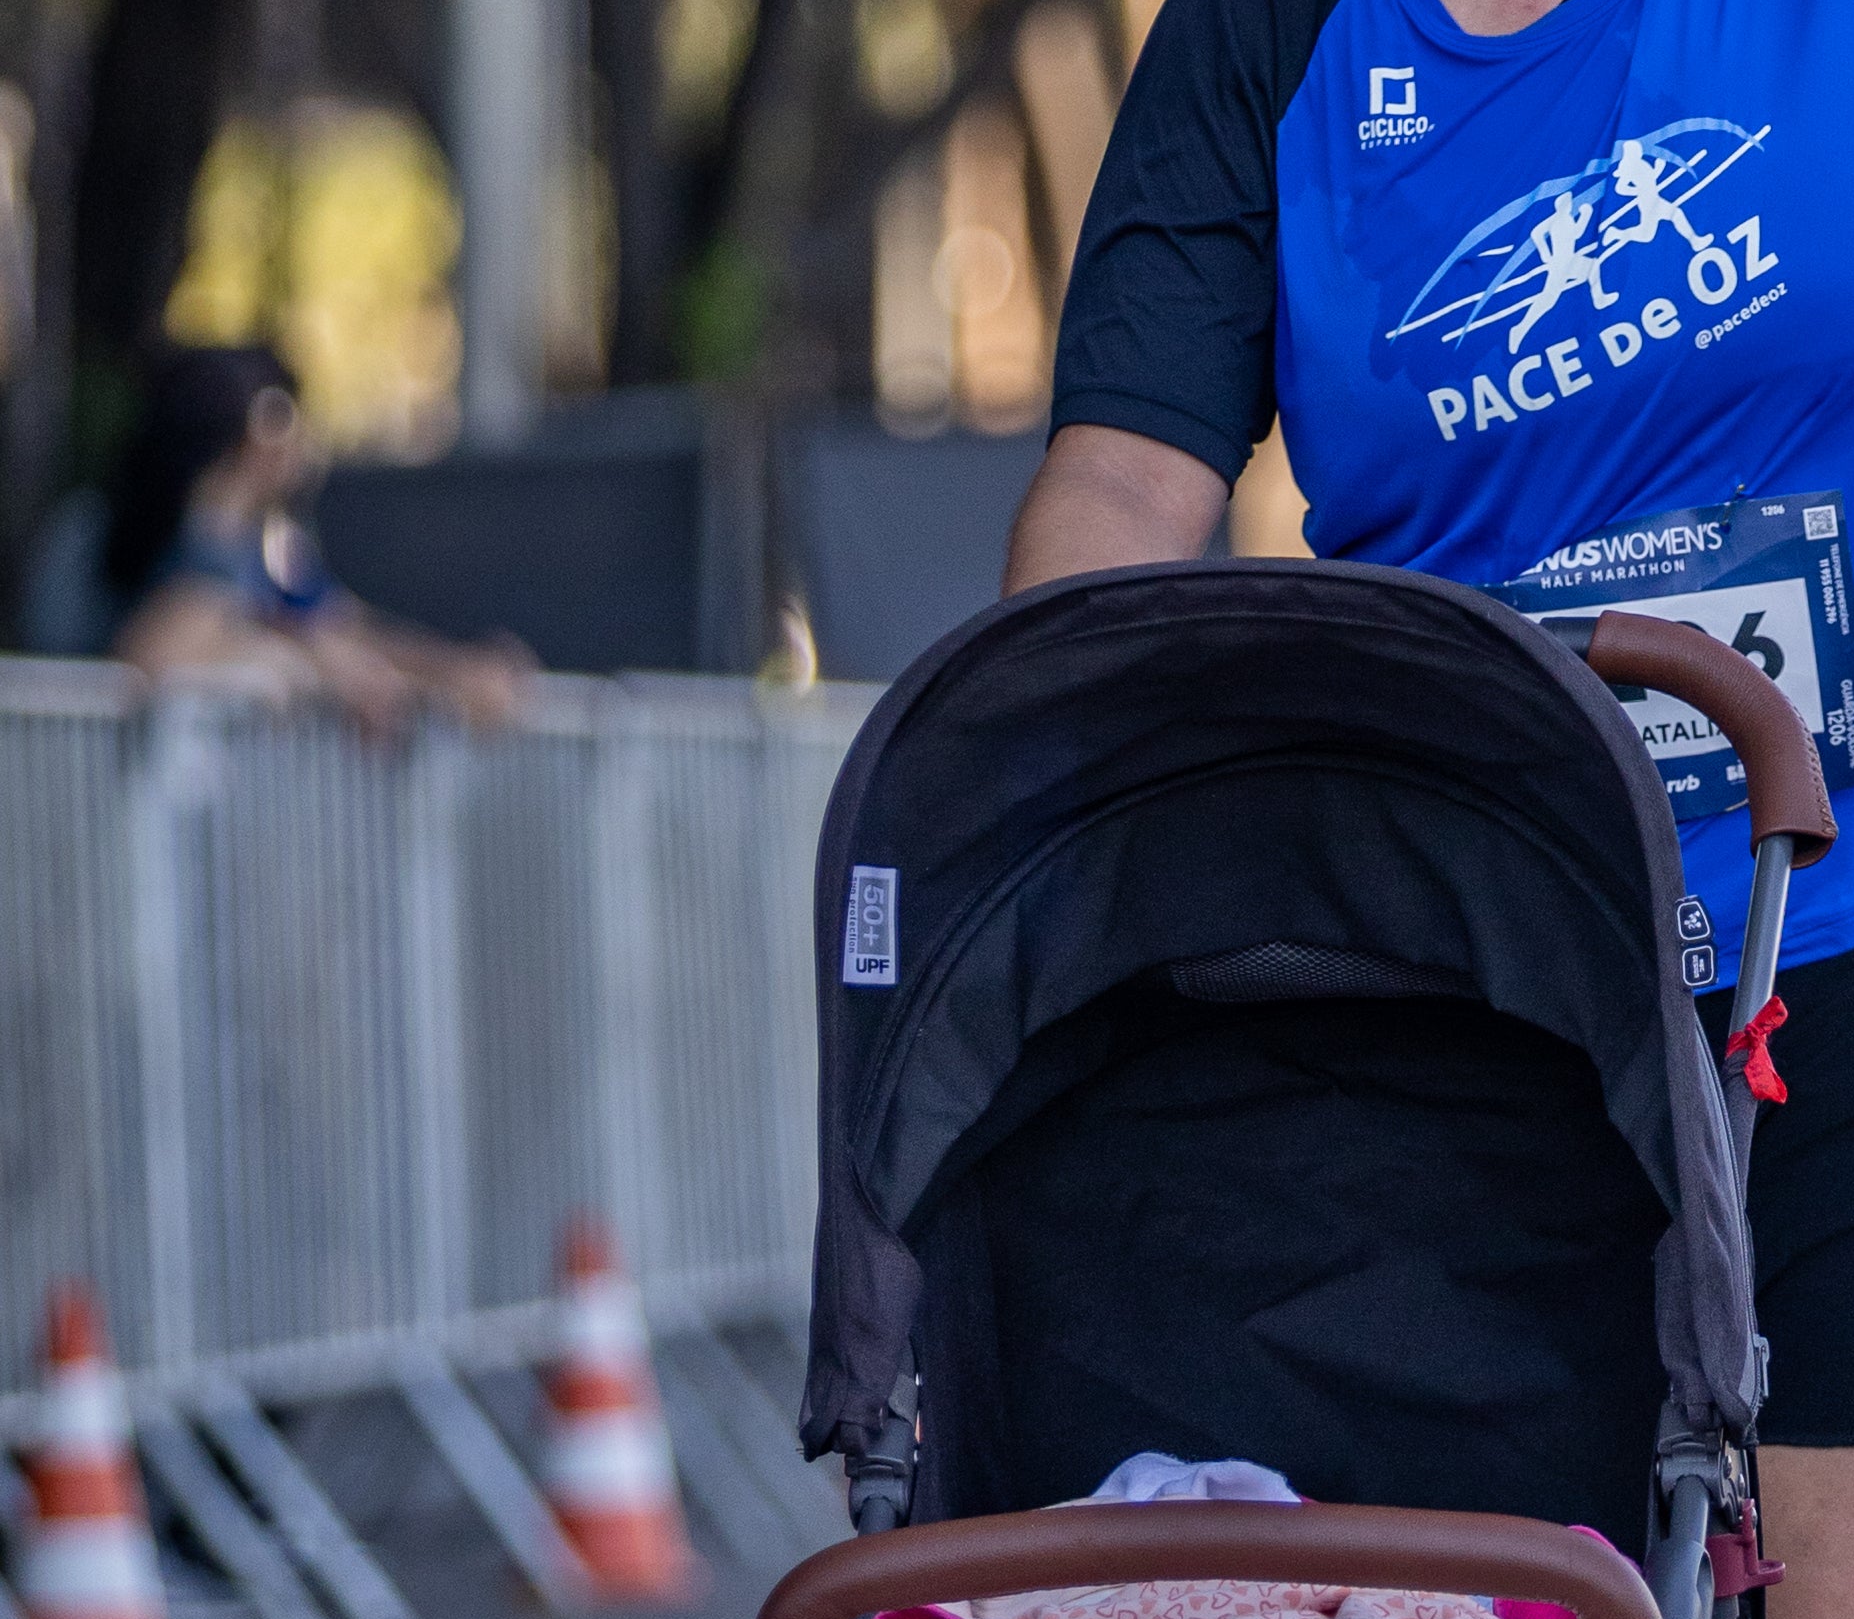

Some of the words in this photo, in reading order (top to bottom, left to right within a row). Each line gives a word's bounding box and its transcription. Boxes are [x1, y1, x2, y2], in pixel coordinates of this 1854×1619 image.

[1428, 337, 1593, 441] PACE
[1599, 298, 1682, 368] De
[1687, 215, 1779, 305] OZ
[1694, 282, 1788, 349] @pacedeoz
[1540, 571, 1583, 590] HALF
[1591, 557, 1686, 583] MARATHON
[1642, 718, 1721, 745] ATALI
[1826, 708, 1847, 746] 1206
[862, 884, 884, 947] 50+
[856, 958, 890, 973] UPF
